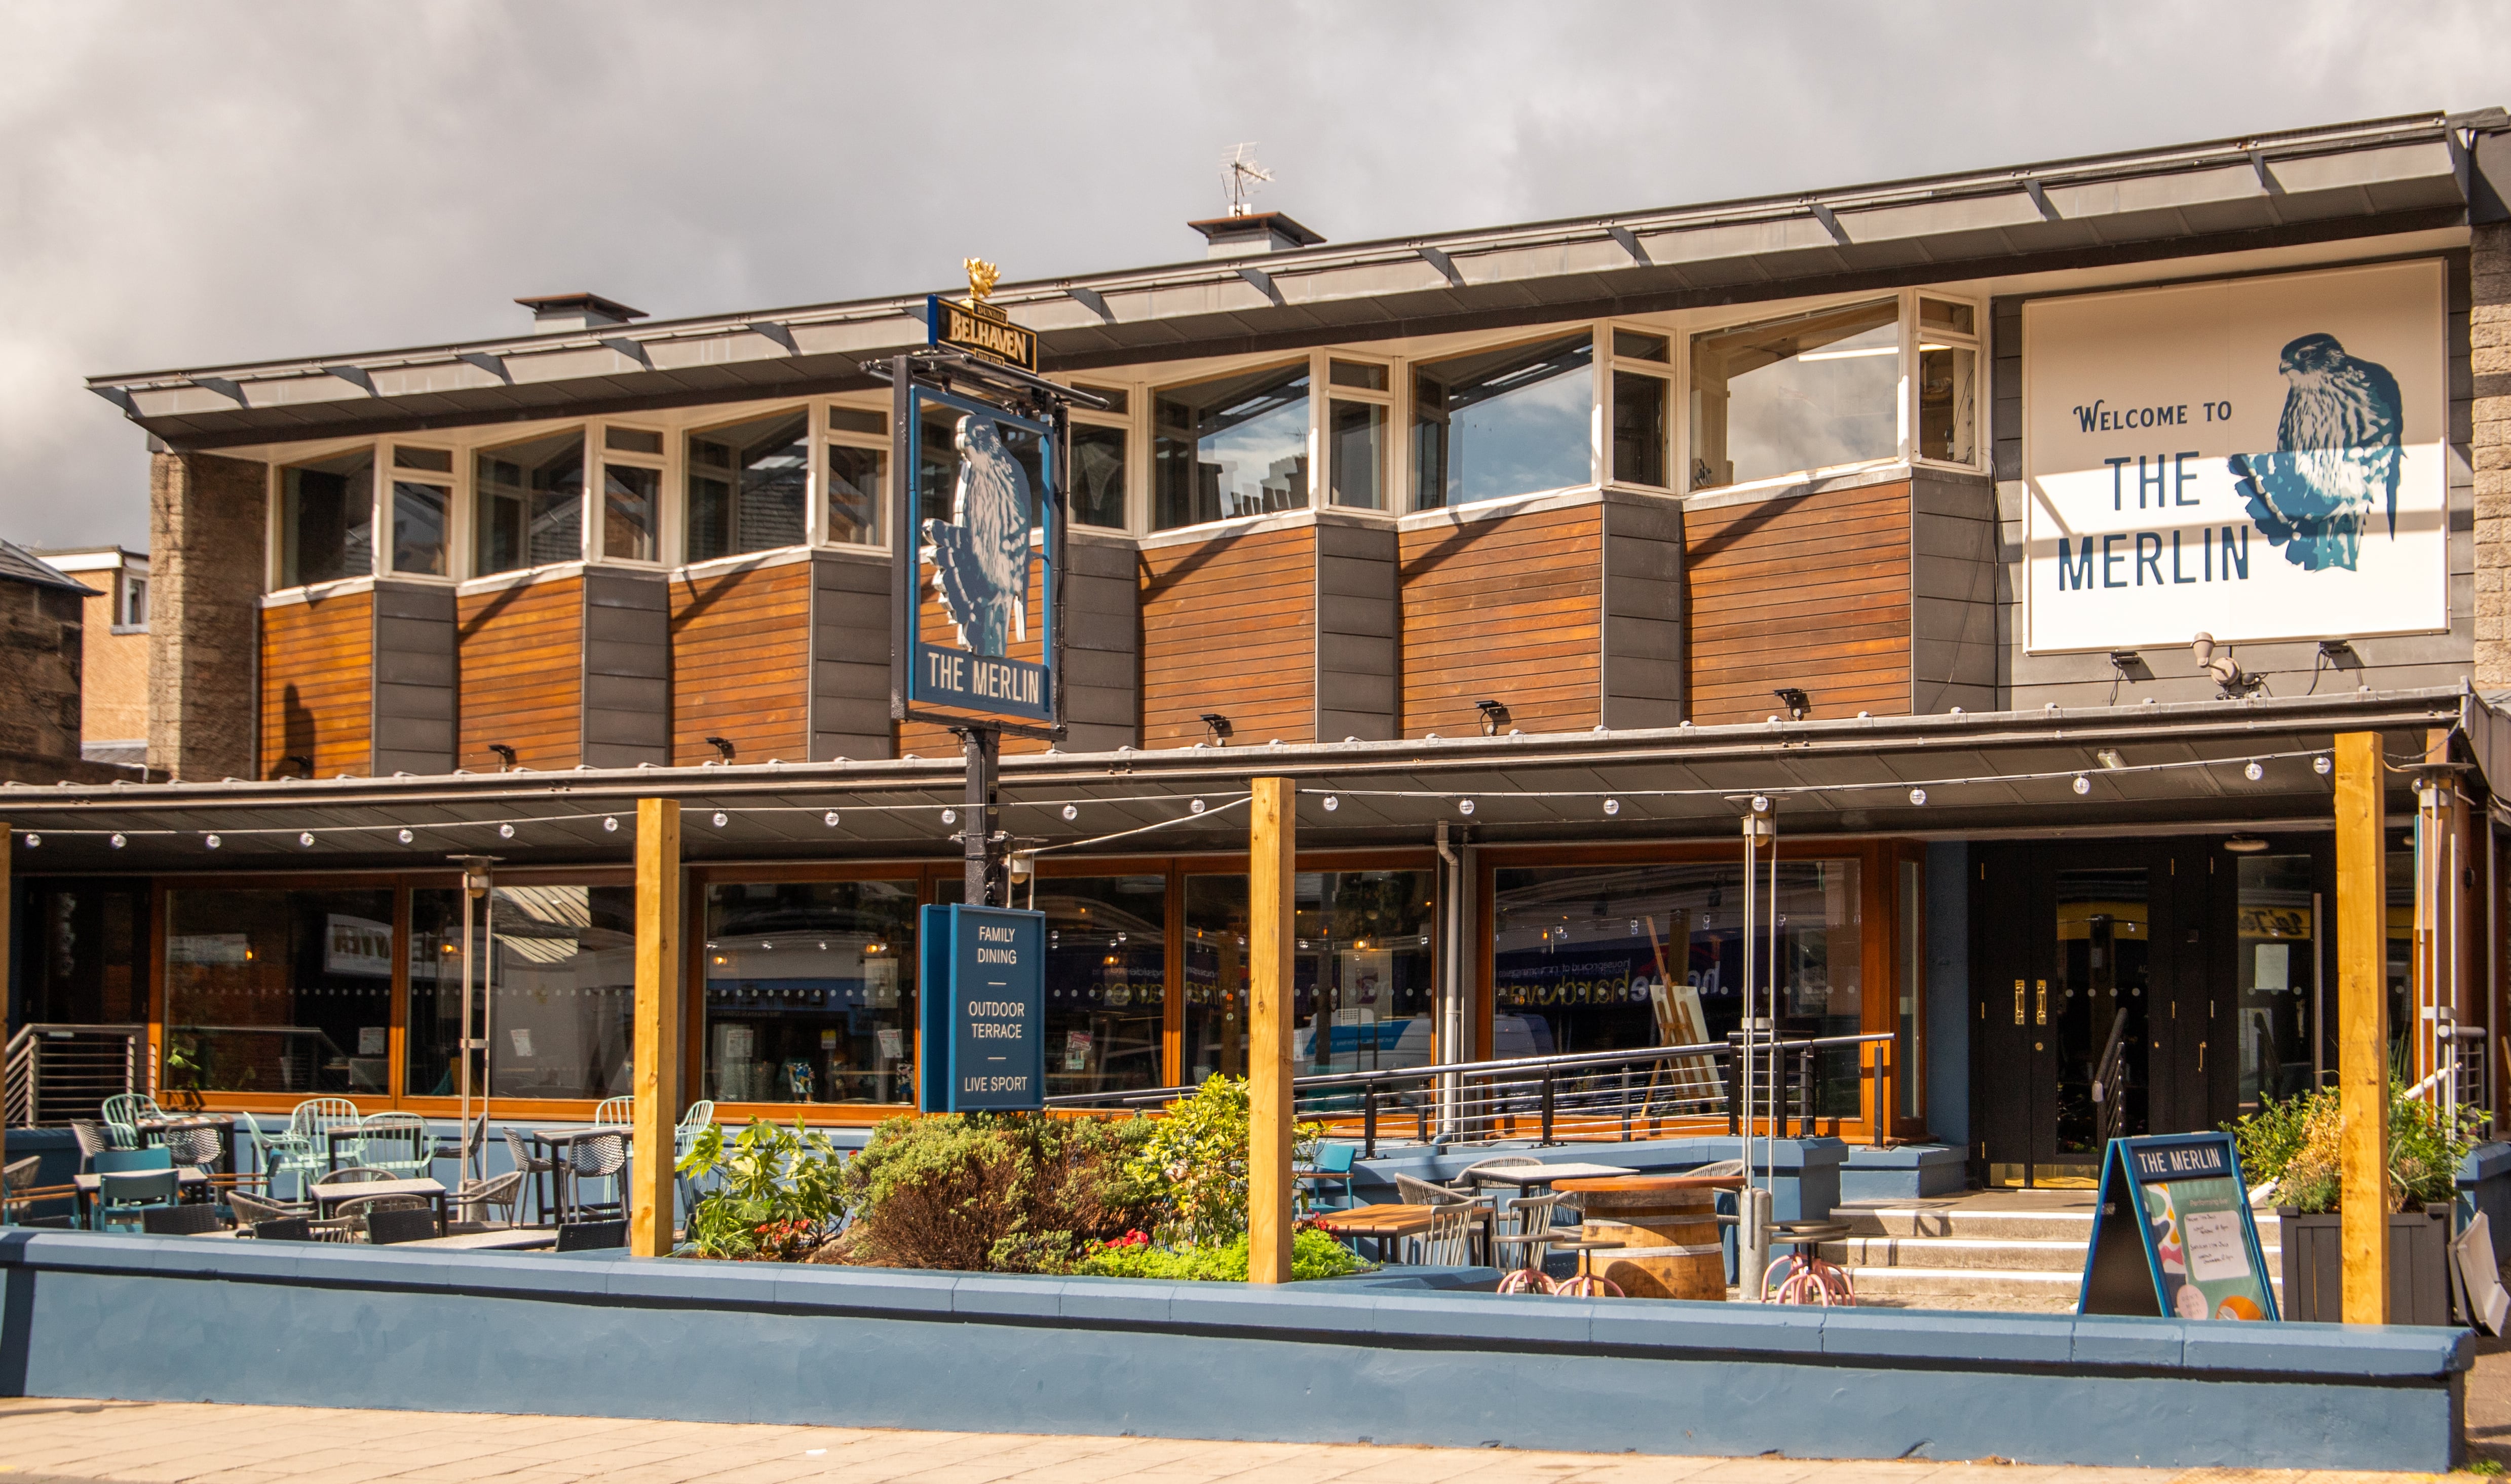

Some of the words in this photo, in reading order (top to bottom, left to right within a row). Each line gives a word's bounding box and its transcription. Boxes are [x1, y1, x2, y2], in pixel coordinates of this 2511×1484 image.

[977, 307, 1006, 323] DUNBAR
[949, 310, 1027, 364] BELHAVEN
[2104, 451, 2200, 511] THE
[2059, 524, 2249, 591] MERLIN
[928, 652, 964, 692] THE
[972, 660, 1039, 704] MERLIN
[978, 926, 1015, 943] FAMILY
[977, 947, 1017, 965] DINING
[968, 1001, 1025, 1018] OUTDOOR
[972, 1022, 1022, 1039] TERRACE
[964, 1076, 988, 1093] LIVE
[991, 1076, 1028, 1092] SPORT
[2138, 1152, 2167, 1174] THE
[2170, 1148, 2221, 1171] MERLIN
